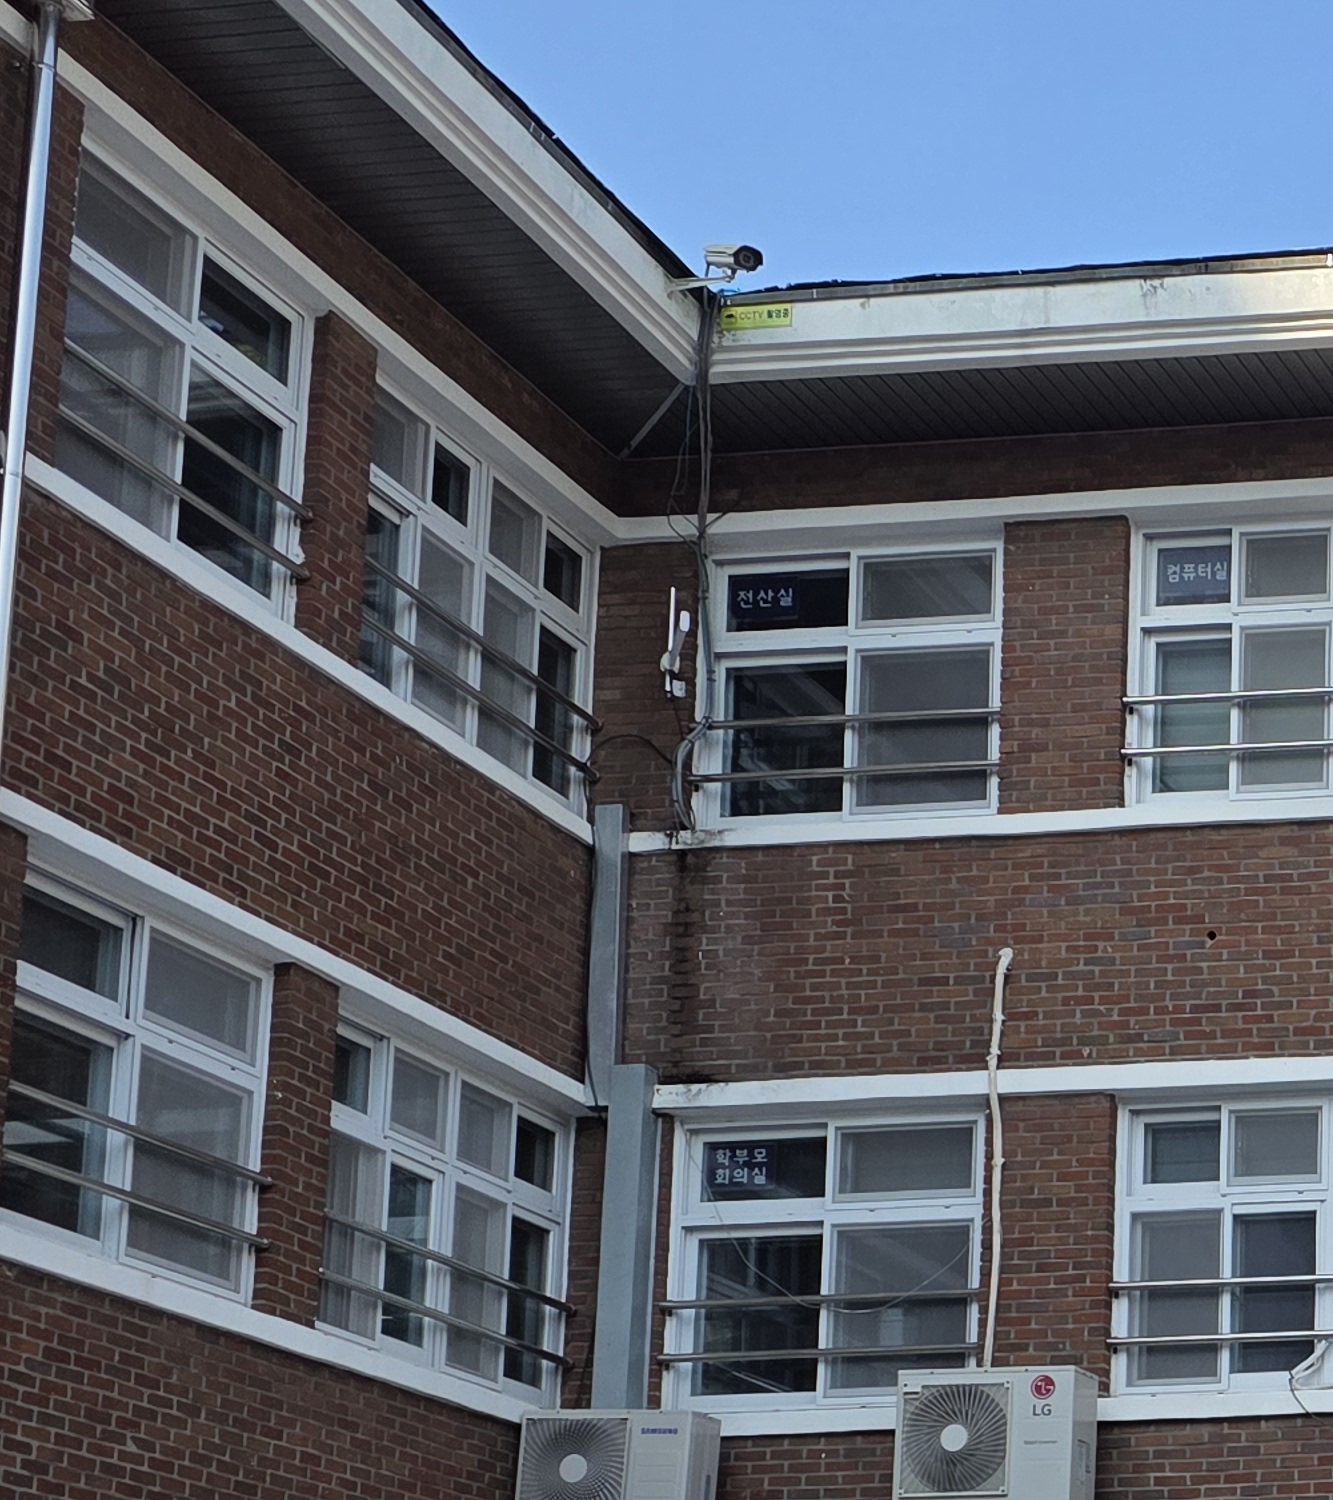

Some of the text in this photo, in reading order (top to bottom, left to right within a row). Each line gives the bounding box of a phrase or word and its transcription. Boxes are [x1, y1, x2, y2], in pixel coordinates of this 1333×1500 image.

[738, 310, 764, 320] CCTV
[1166, 561, 1228, 583] 컴퓨터실
[736, 587, 793, 609] 전산실
[714, 1148, 768, 1166] 학부모
[714, 1166, 767, 1185] 회의실
[1032, 1403, 1052, 1417] LG
